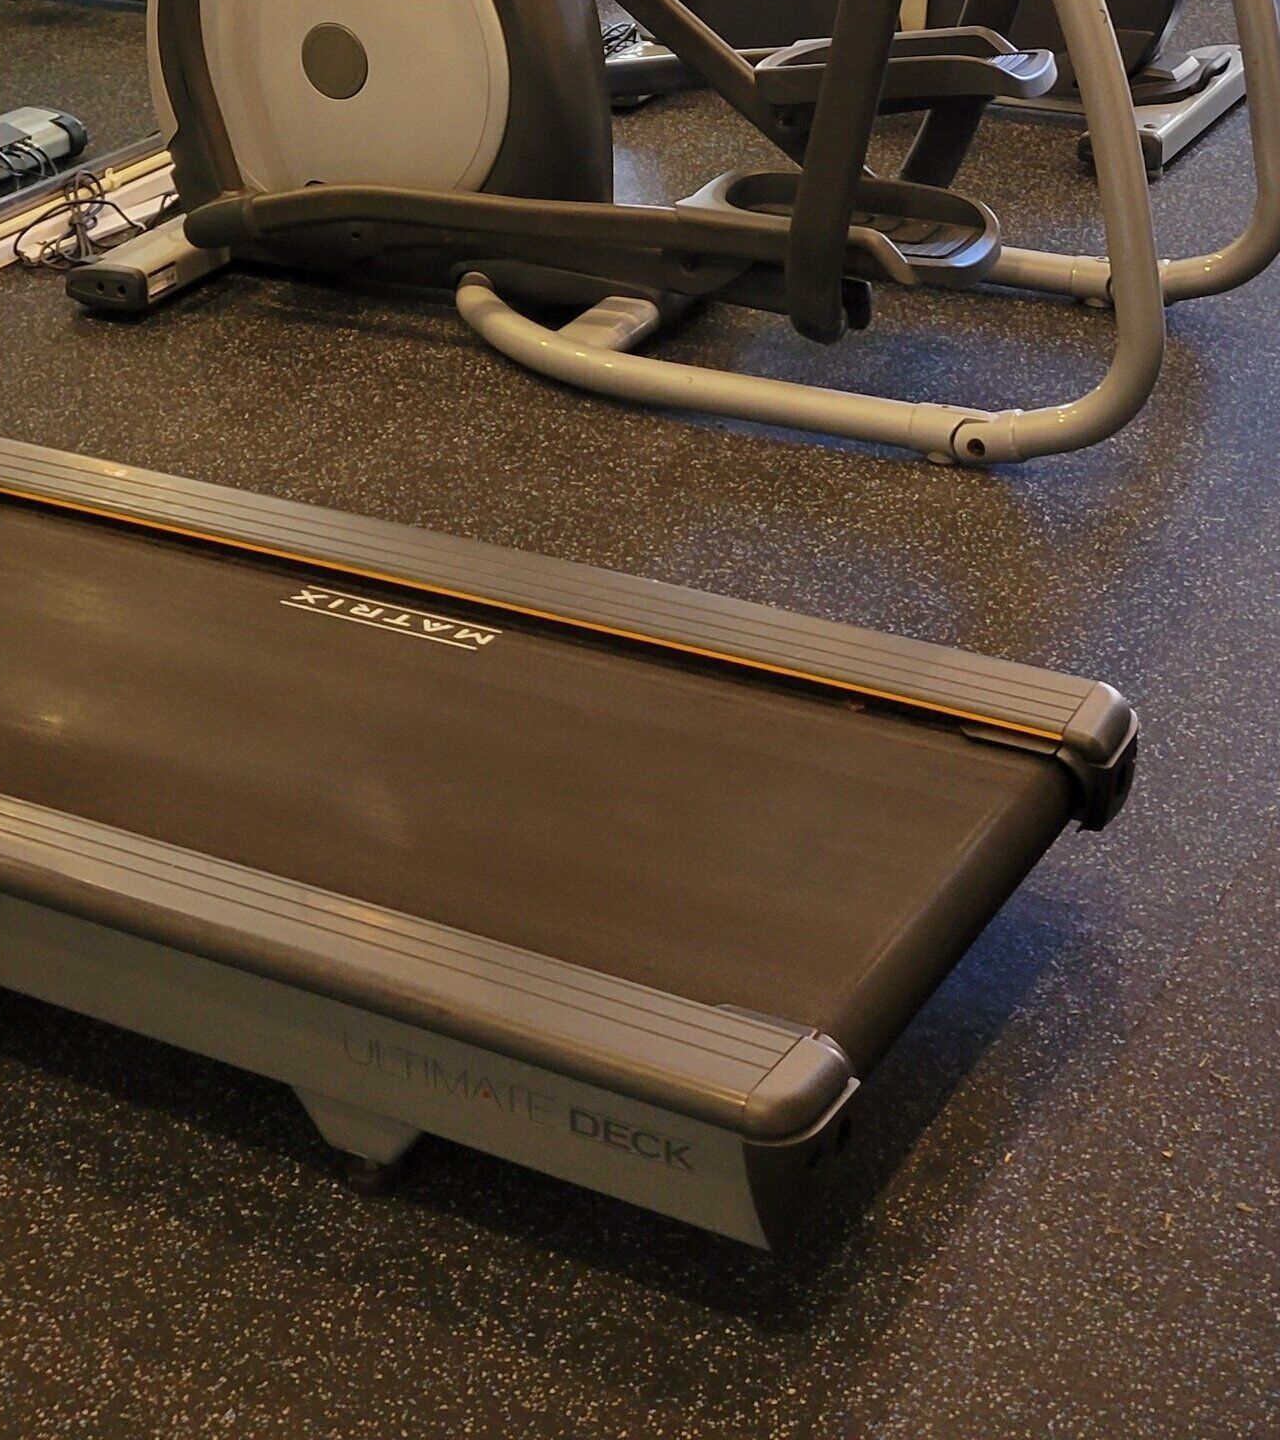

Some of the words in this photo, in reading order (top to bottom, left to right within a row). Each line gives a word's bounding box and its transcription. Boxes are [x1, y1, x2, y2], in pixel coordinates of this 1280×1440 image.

[290, 589, 496, 646] MATRIX
[338, 1027, 557, 1129] ULTIMATE
[569, 1104, 696, 1175] DECK
